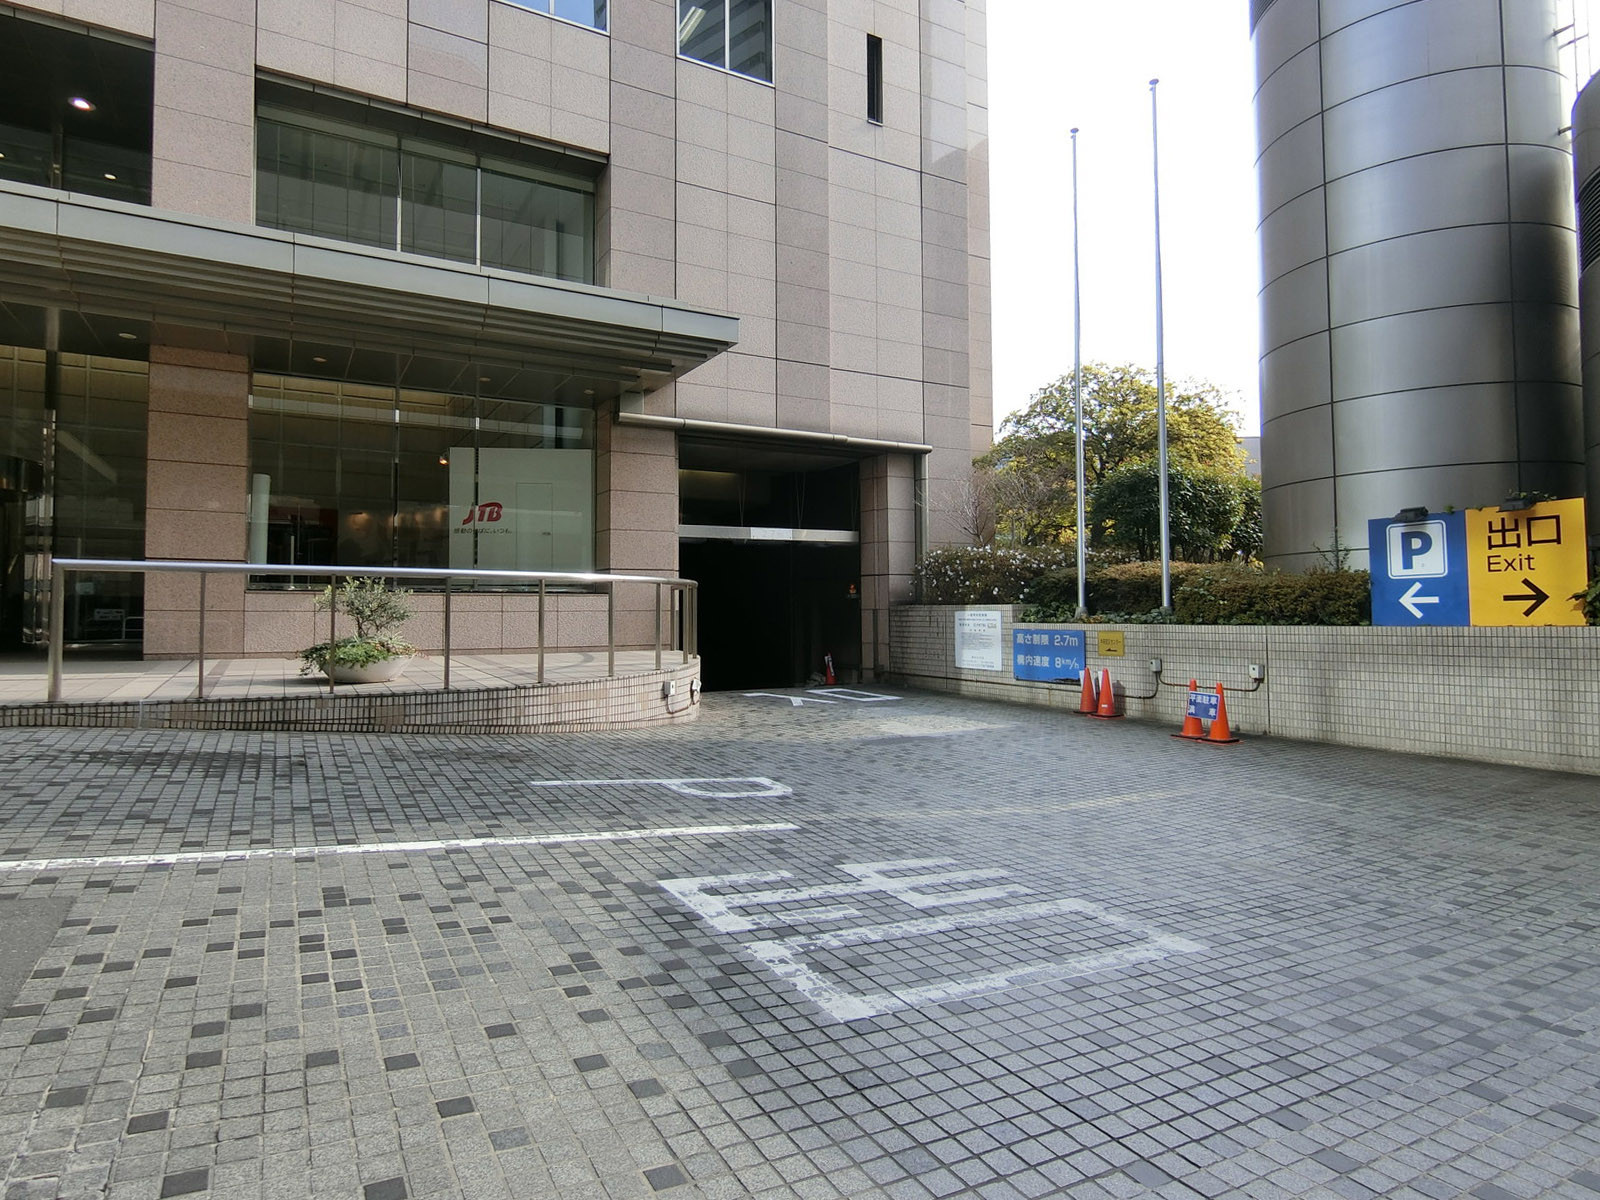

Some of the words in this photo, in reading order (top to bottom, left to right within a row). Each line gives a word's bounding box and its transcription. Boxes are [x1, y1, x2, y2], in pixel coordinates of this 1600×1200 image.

[462, 502, 503, 525] JTB
[1487, 514, 1562, 551] 出口
[1400, 530, 1433, 570] P
[1487, 553, 1536, 573] Exit
[1016, 633, 1050, 646] 高さ制限
[1054, 656, 1080, 669] 8km/h
[657, 855, 1211, 1024] 出口
